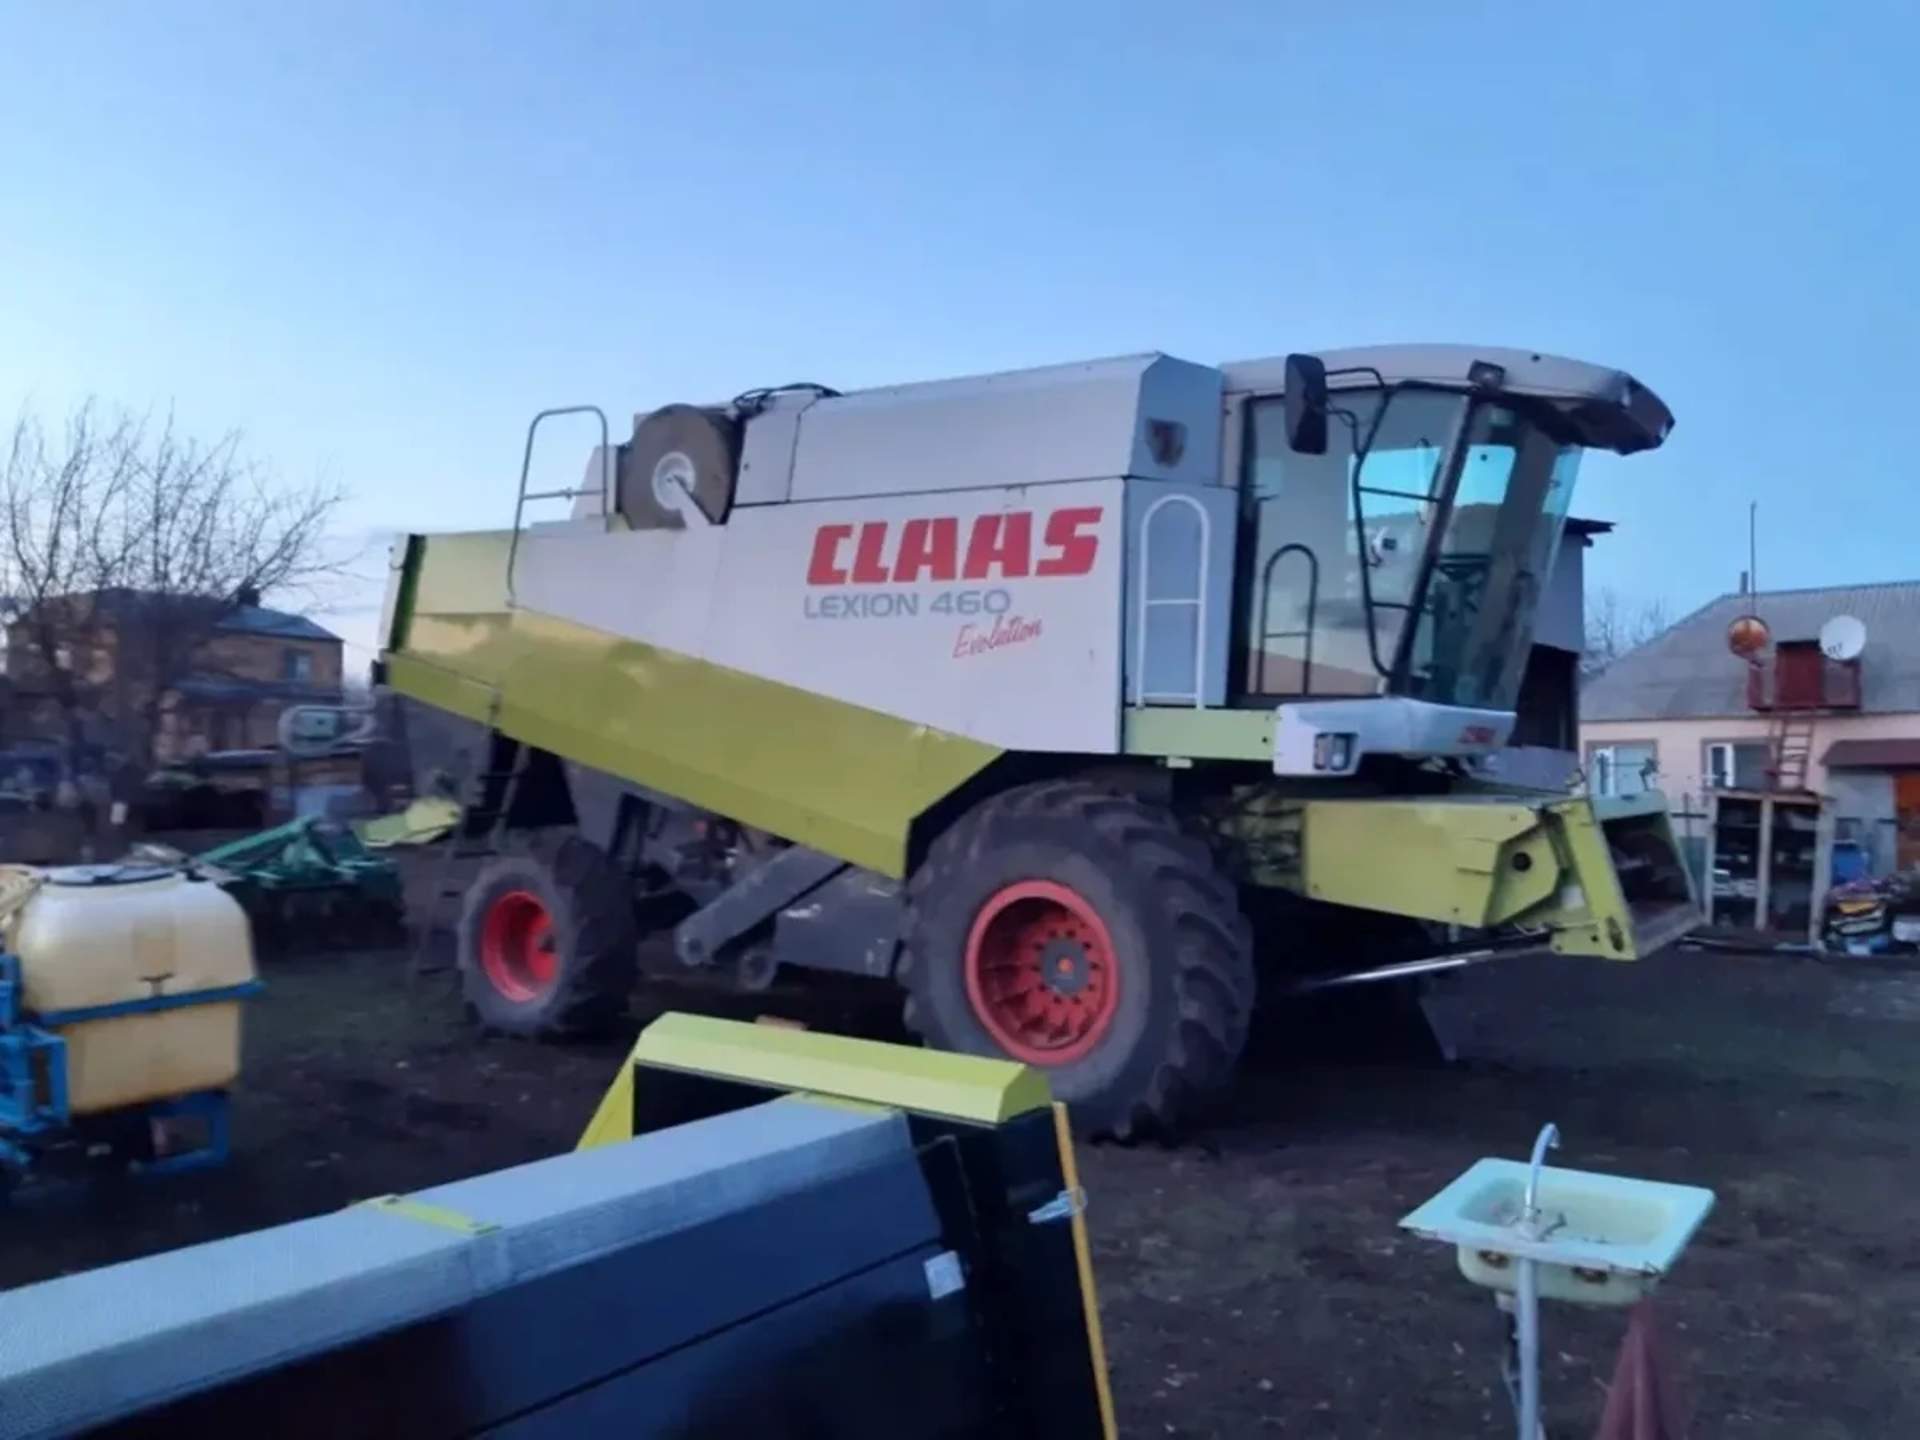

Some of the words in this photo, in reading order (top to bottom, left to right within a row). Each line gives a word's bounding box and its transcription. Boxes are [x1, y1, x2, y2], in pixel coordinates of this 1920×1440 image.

[806, 506, 1104, 585] CLAAS
[803, 593, 919, 619] LEXION
[929, 589, 1011, 615] 460
[952, 615, 1043, 658] Evolution
